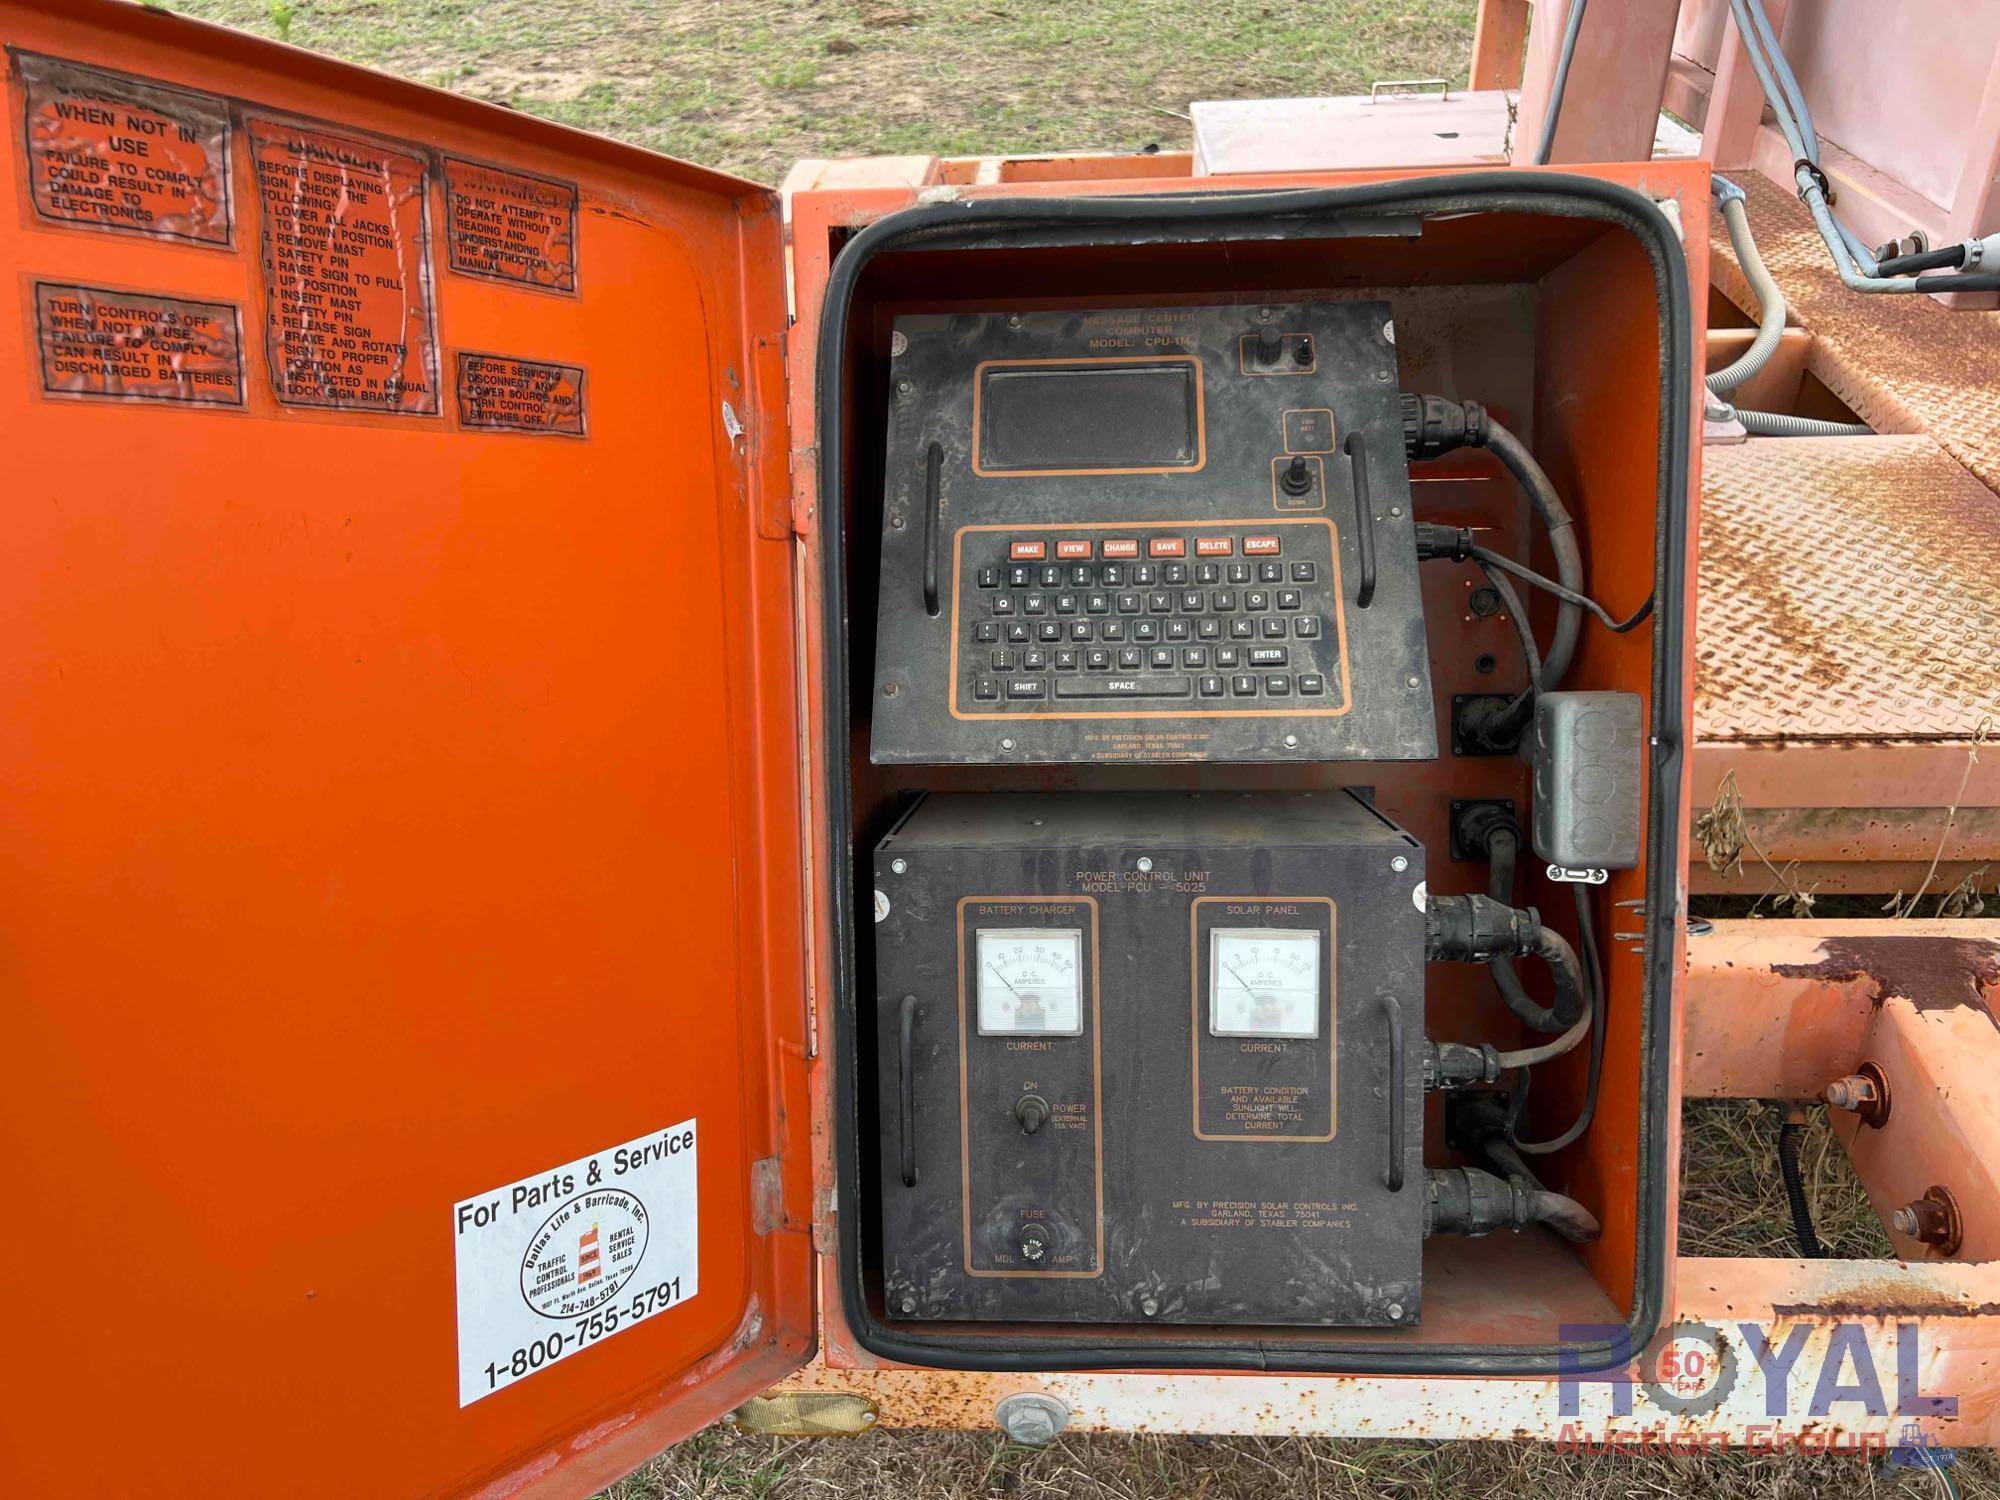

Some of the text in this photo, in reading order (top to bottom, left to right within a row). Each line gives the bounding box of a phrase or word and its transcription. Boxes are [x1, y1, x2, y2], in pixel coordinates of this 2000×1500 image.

[55, 102, 196, 144] WHEN NOT IN
[109, 137, 148, 157] USE
[46, 150, 202, 188] FAILURE TO COMPLY
[259, 160, 382, 195] BEFORE DISPLAYING
[48, 166, 185, 199] COULD RESULT IN
[49, 182, 141, 206] DAMAGE TO
[300, 183, 367, 204] CHECK THE
[51, 197, 153, 221] ELECTRONICS
[457, 194, 561, 225] DO NOT ATTEMPT TO
[274, 206, 389, 236] LOWER ALL JACKS
[457, 207, 550, 235] OPERATE WITHOUT
[457, 219, 526, 241] READING AND
[276, 219, 393, 250] TO DOWN POSITION
[459, 232, 539, 256] UNDERSTANDING
[277, 233, 364, 257] REMOVE MAST
[278, 248, 348, 268] SAFETY PIN
[459, 244, 546, 270] THE INSTRUCTION
[279, 262, 403, 290] RAISE SIGN TO FULL
[280, 275, 357, 297] UP POSITION
[281, 290, 361, 311] INSERT MAST
[49, 300, 210, 328] TURN CONTROLS OFF
[282, 304, 352, 323] SAFETY PIN
[49, 316, 195, 340] WHEN NOT USE.
[283, 318, 371, 338] RELEASE SIGN
[1107, 325, 1172, 336] COMPUTER
[52, 331, 207, 356] FAILURE TO COMPLY
[284, 331, 355, 349] BRAKE AND
[1090, 339, 1135, 348] MODEL:
[53, 346, 171, 365] CAN RESULT IN
[285, 345, 388, 365] SIGN TO PROPER
[55, 361, 150, 378] DISCHARGED
[348, 364, 362, 375] AS
[468, 361, 560, 381] BEFORE SERVICING
[367, 379, 377, 388] IN
[468, 375, 554, 391] DISCONNECT ANY
[289, 385, 400, 402] LOCK SIGN BRAKE
[468, 386, 571, 405] POWER SOURCE AND
[470, 399, 545, 413] TURN CONTROL
[470, 410, 519, 422] SWITCHES
[1104, 544, 1136, 552] CHANGE
[1247, 540, 1276, 548] ESCAPE
[1255, 651, 1281, 659] ENTER
[1109, 682, 1136, 690] SPACE
[1077, 872, 1211, 881] POWER CONTROL UNIT
[1082, 883, 1206, 892] MODEL PCU 5025
[980, 906, 1076, 914] BATTERY CHARGER
[1227, 906, 1299, 914] SOLAR PANEL
[1007, 1042, 1052, 1050] CURRENT
[1241, 1044, 1287, 1052] CURRENT
[1024, 1081, 1037, 1090] ON
[1053, 1104, 1085, 1112] POWER
[458, 1130, 693, 1234] For Parts & Service
[1020, 1210, 1045, 1218] FUSE
[1191, 1219, 1240, 1227] SUBSIDIARY
[1245, 1219, 1255, 1227] OF
[1303, 1220, 1351, 1228] COMPANIES
[525, 1194, 643, 1268] Dallas Lite Barricade, Inc.
[609, 1227, 633, 1242] RENTAL
[609, 1236, 635, 1253] SERVICE
[538, 1254, 566, 1272] TRAFFIC
[612, 1248, 632, 1262] SALES
[995, 1255, 1014, 1263] MDL
[536, 1265, 567, 1284] CONTROL
[529, 1272, 575, 1298] PROFESSIONALS
[560, 1281, 618, 1314] 214-748-5791
[485, 1277, 681, 1389] 1-800-755-5791
